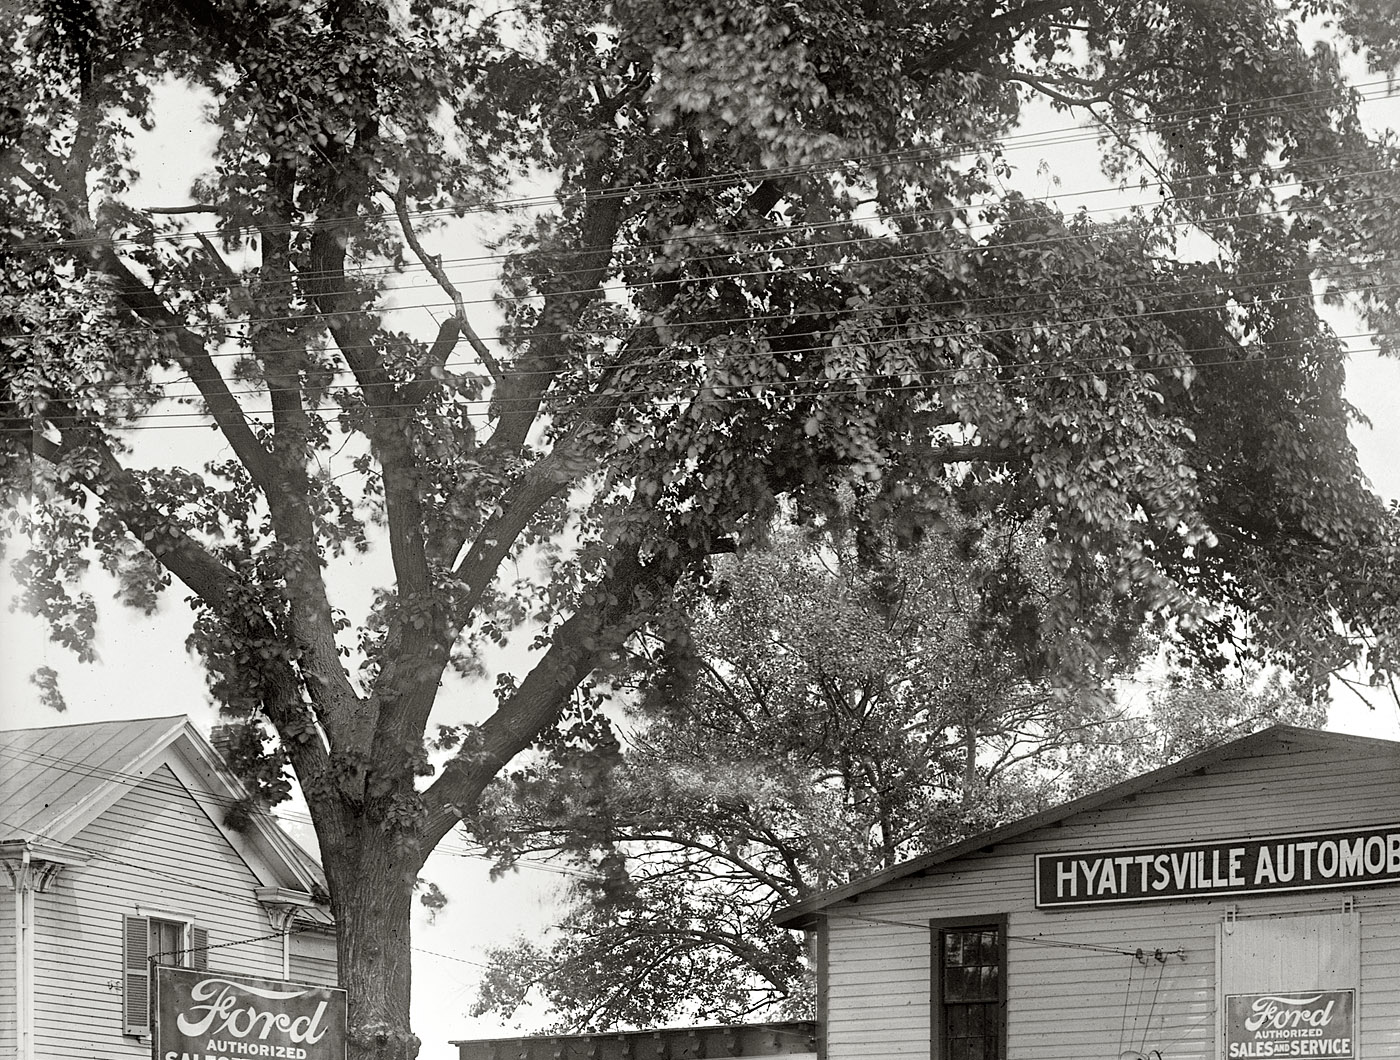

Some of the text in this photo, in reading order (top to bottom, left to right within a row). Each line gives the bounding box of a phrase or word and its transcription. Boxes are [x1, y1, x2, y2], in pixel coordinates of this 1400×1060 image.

[1056, 848, 1246, 898] HYATTSVILLE
[176, 978, 328, 1045] Ford
[1244, 994, 1335, 1031] Ford
[1228, 1038, 1351, 1058] SALES AND SERVICE
[1254, 1029, 1323, 1040] AUTHORIZED
[206, 1039, 307, 1060] AUTHORIZED
